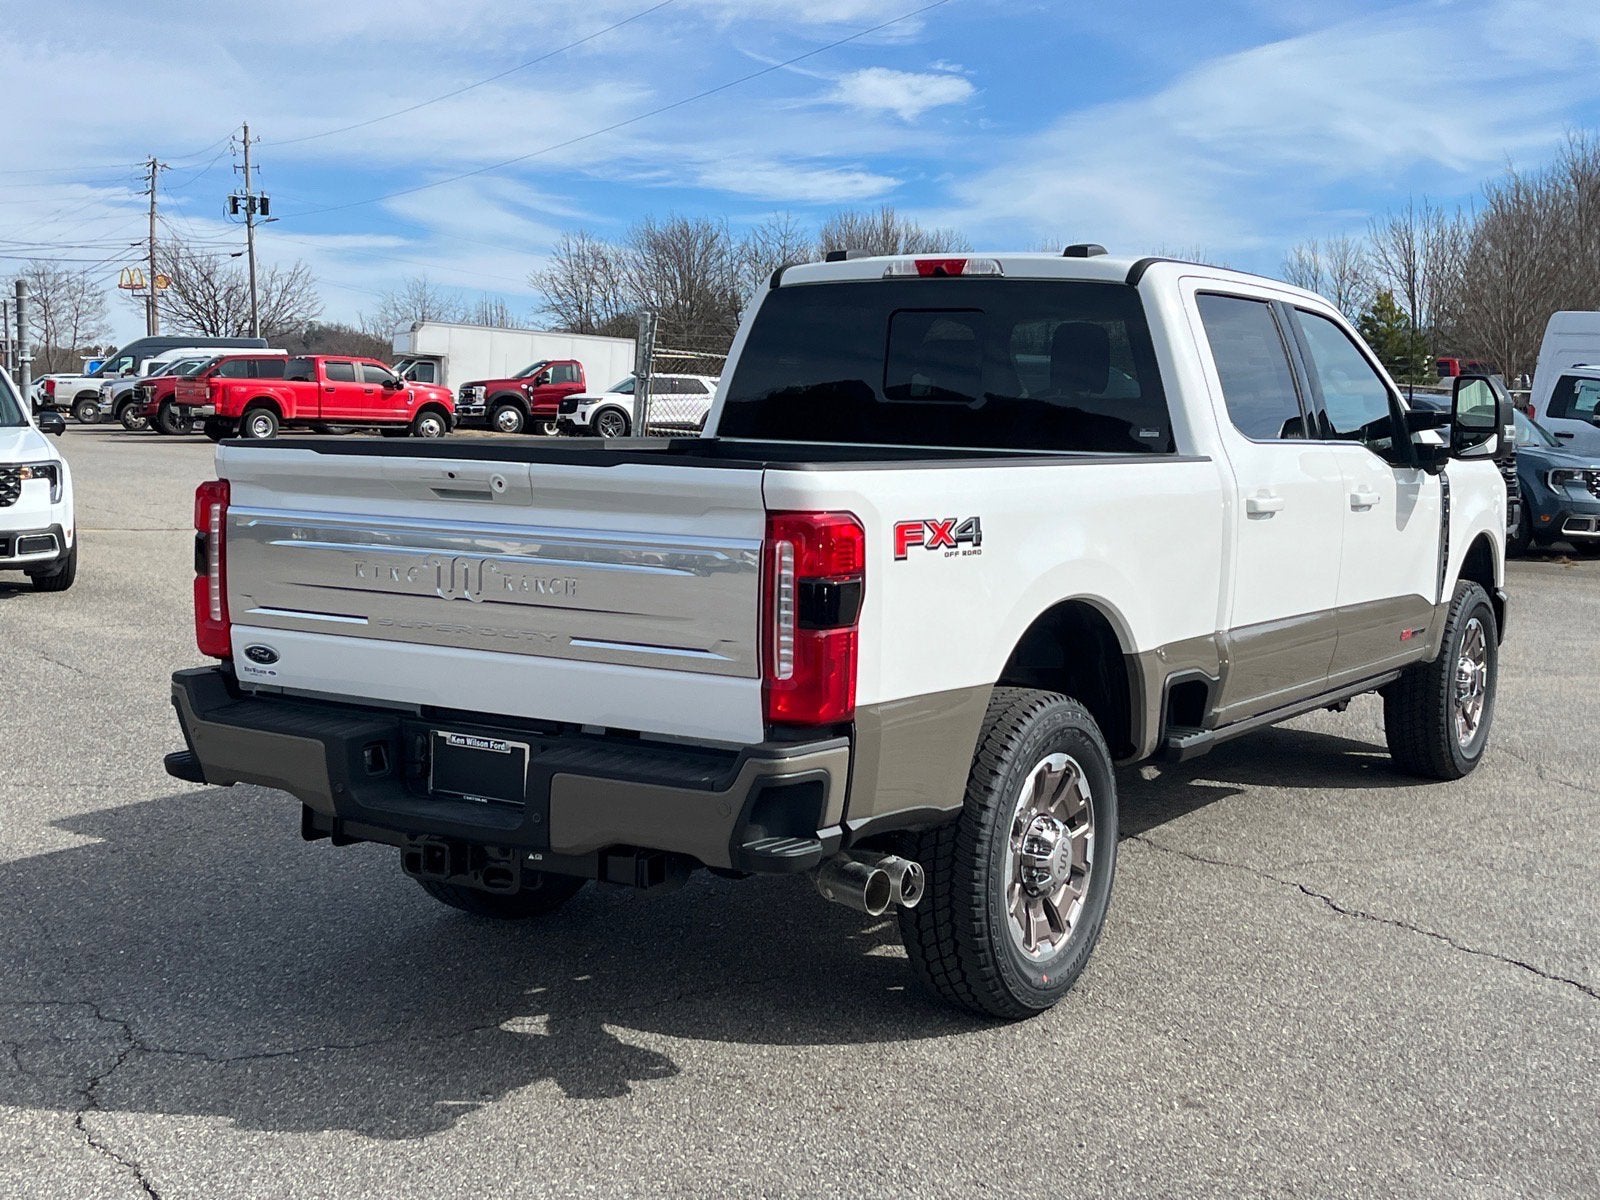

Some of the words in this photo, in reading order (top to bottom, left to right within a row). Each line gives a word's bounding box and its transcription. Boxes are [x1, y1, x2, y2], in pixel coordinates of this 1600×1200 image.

[893, 516, 982, 562] FX4
[944, 550, 960, 558] OFF
[354, 559, 419, 583] KING
[503, 572, 578, 597] RANCH
[377, 617, 474, 636] SUPER
[479, 626, 559, 643] DUTY
[451, 735, 465, 745] Ken
[467, 738, 489, 748] Wilson
[490, 740, 505, 750] Ford
